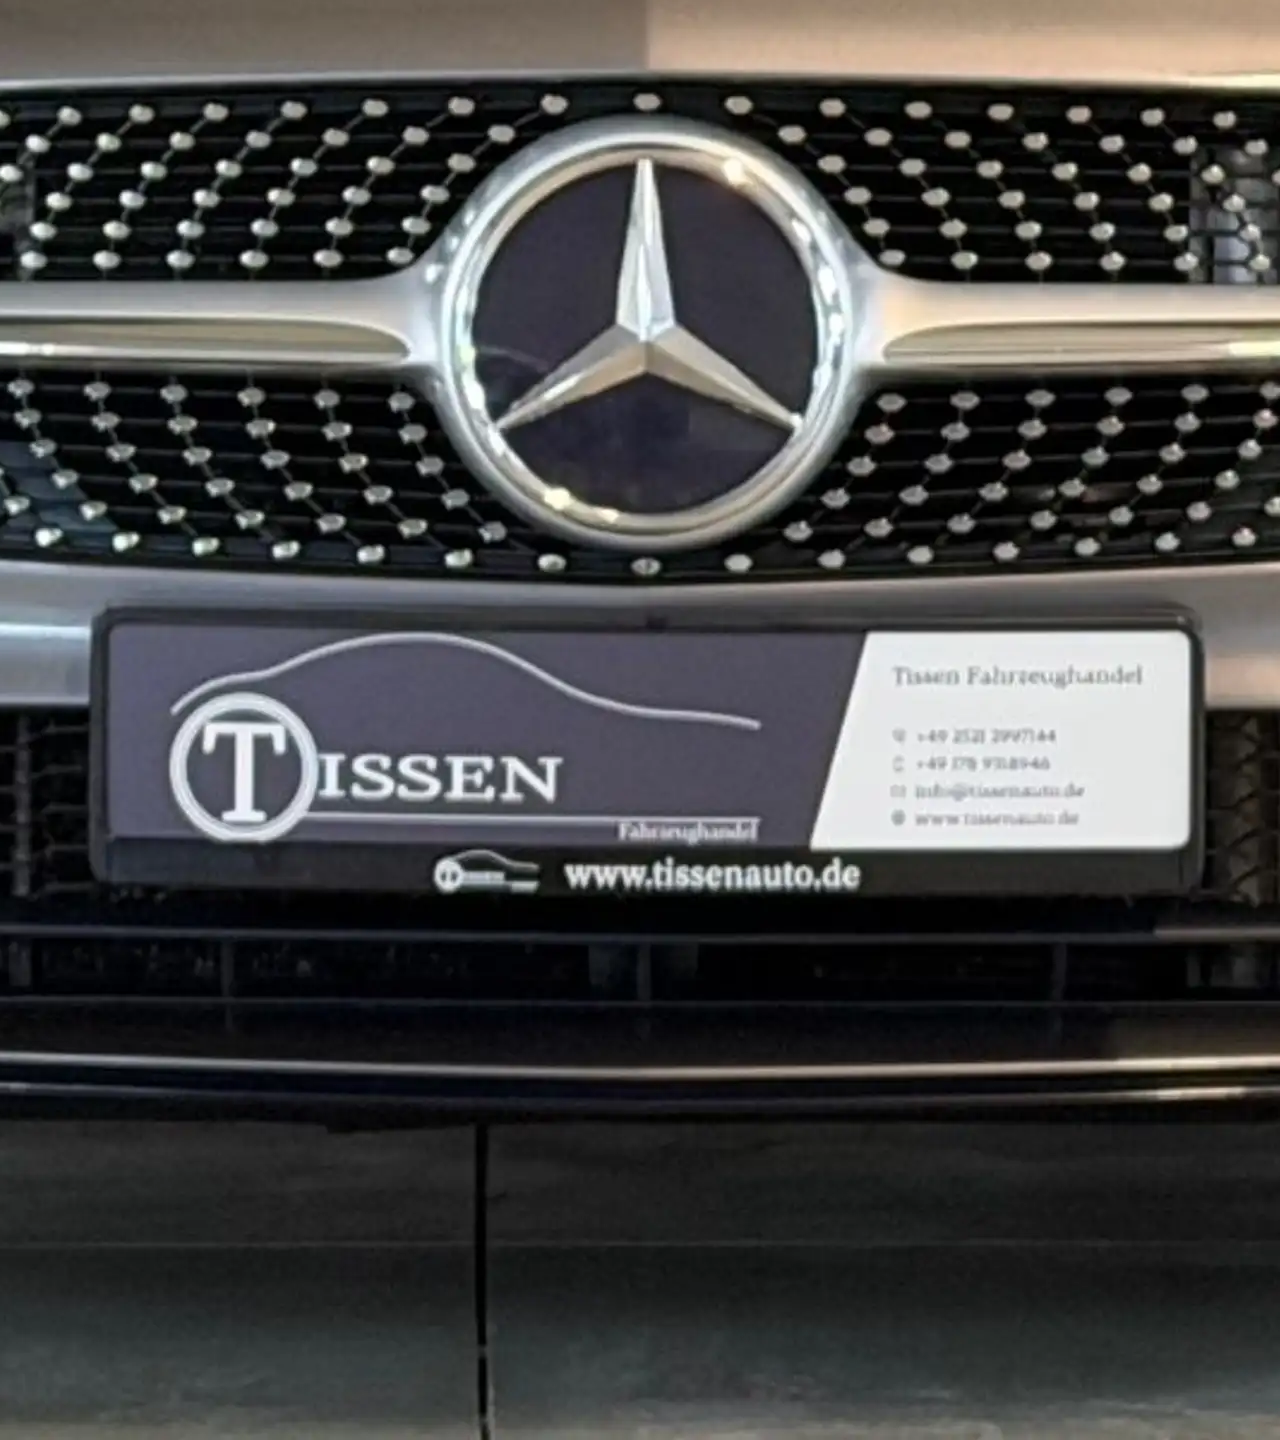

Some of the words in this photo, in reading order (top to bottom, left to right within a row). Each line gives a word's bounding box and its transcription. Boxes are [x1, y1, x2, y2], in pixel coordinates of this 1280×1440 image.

[892, 664, 960, 686] Tissen
[966, 663, 1143, 689] Fahrzeughandel
[917, 729, 948, 743] +49
[564, 857, 861, 891] www.tissenauto.de
